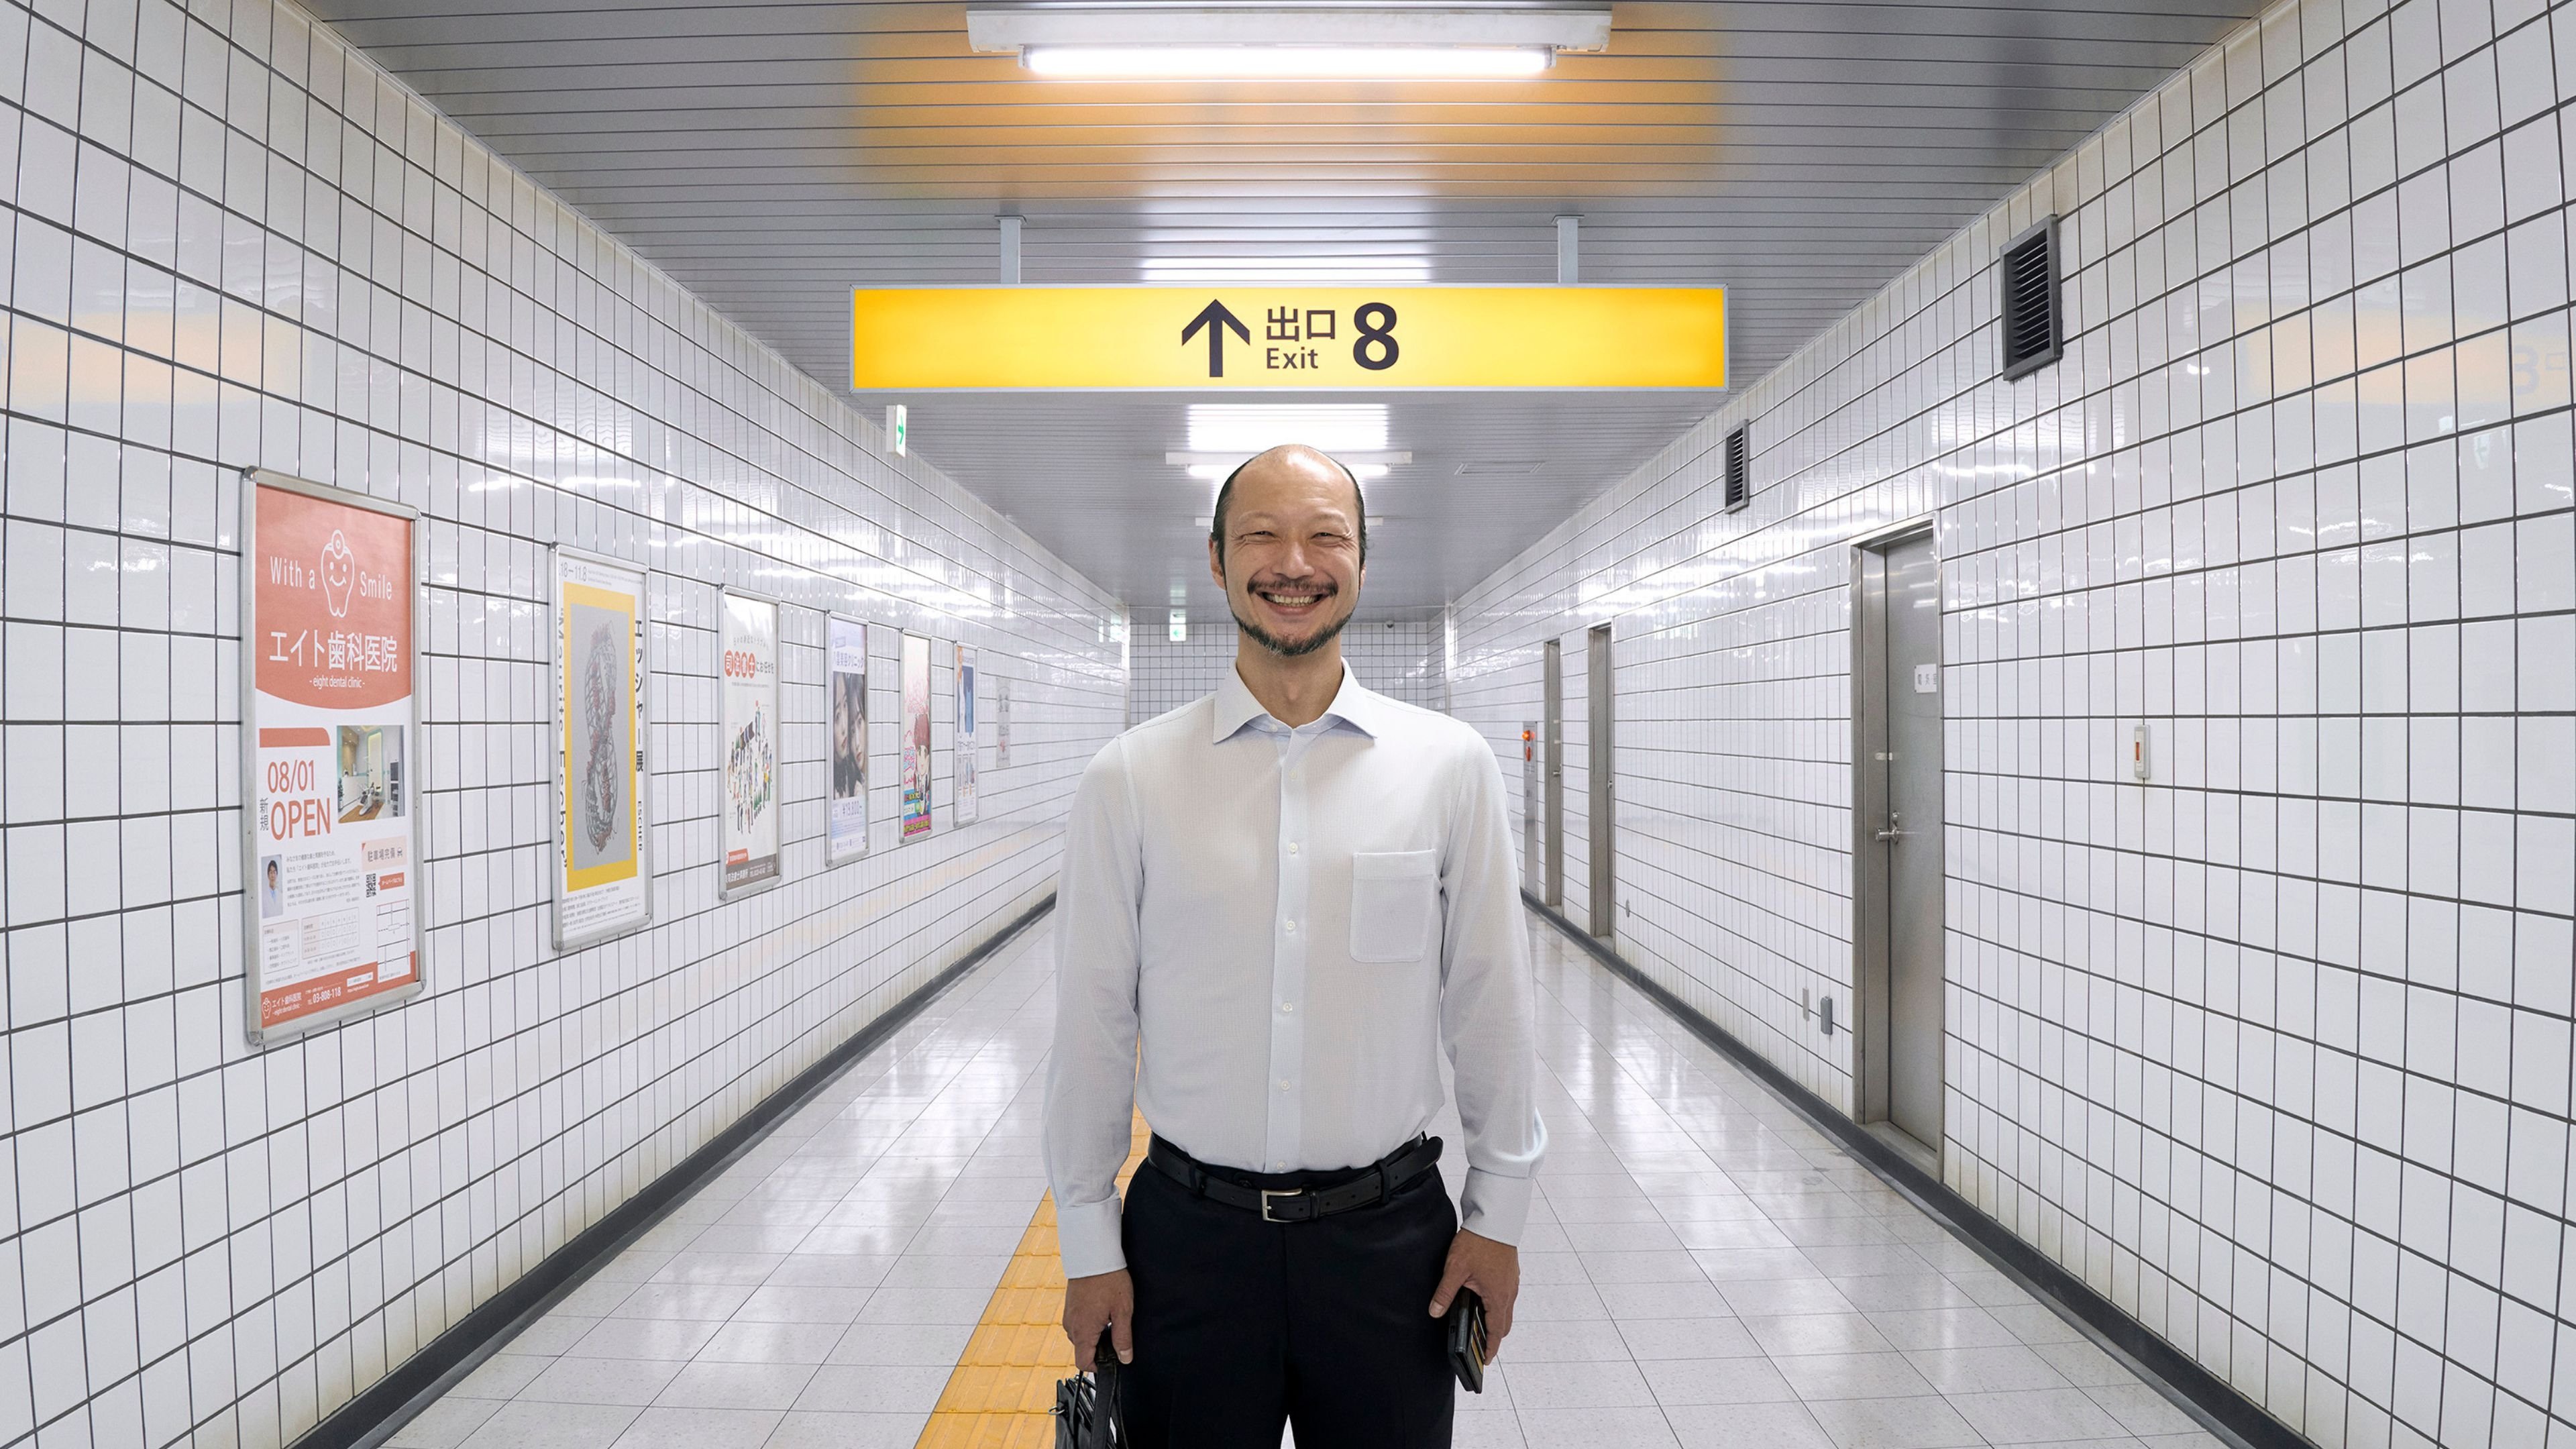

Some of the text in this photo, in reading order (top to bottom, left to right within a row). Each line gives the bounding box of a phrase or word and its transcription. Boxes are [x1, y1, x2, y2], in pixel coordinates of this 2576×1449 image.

[1267, 307, 1334, 341] 出口
[1354, 303, 1399, 370] 8
[1267, 347, 1318, 369] Exit
[270, 556, 392, 600] With a Smile
[270, 629, 397, 672] エイト歯科医院
[329, 675, 347, 688] dental
[268, 759, 314, 794] 08/01
[271, 798, 331, 841] OPEN
